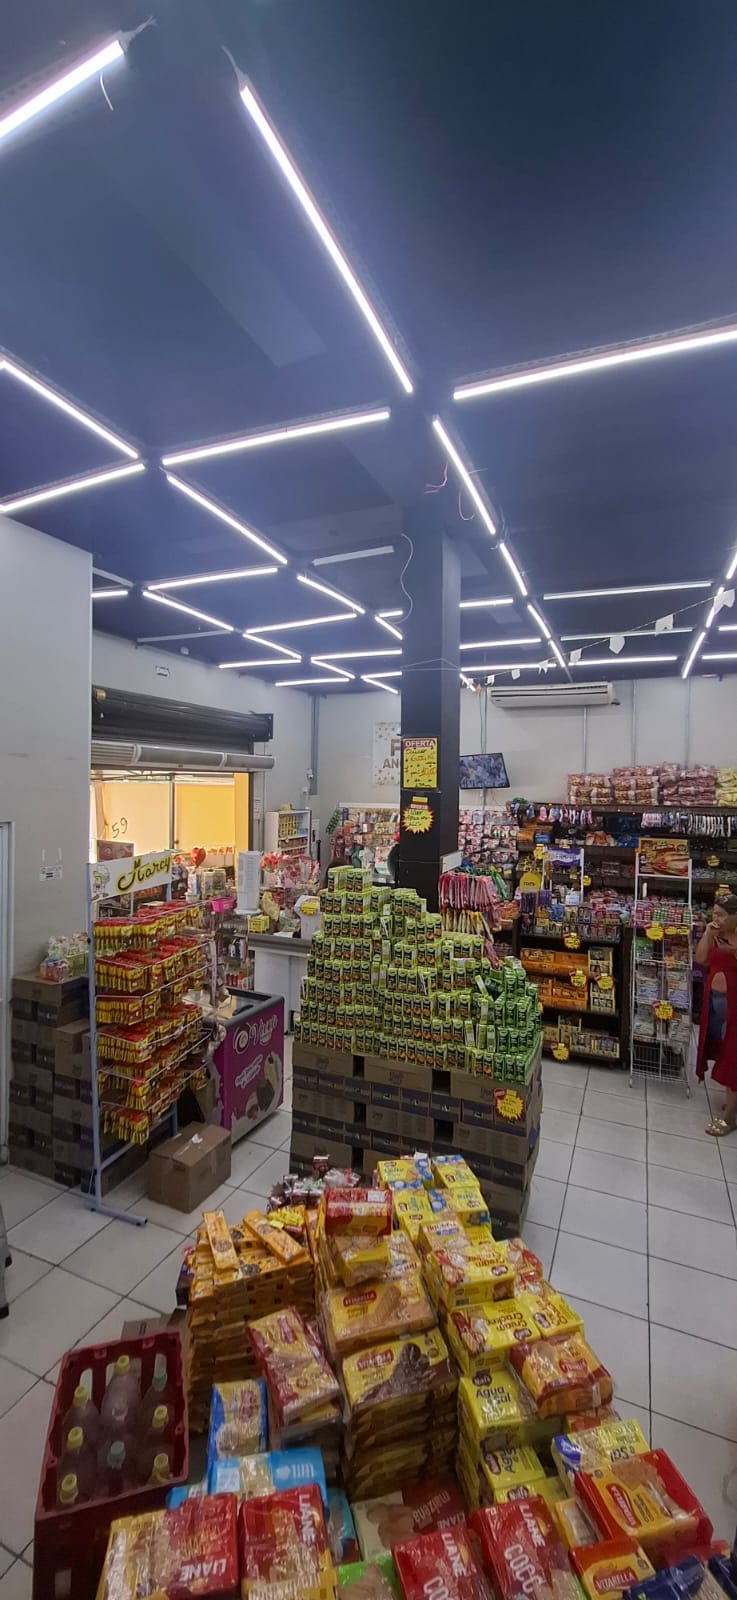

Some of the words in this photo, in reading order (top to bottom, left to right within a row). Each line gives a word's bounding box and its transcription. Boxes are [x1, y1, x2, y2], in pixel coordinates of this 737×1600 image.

[112, 817, 128, 838] 59
[497, 1320, 527, 1331] Cream
[299, 1493, 316, 1547] LIANE
[519, 1504, 545, 1547] LIANE
[441, 1532, 467, 1578] LIANE
[180, 1558, 227, 1583] LIANE
[596, 1571, 634, 1590] VITARELLA
